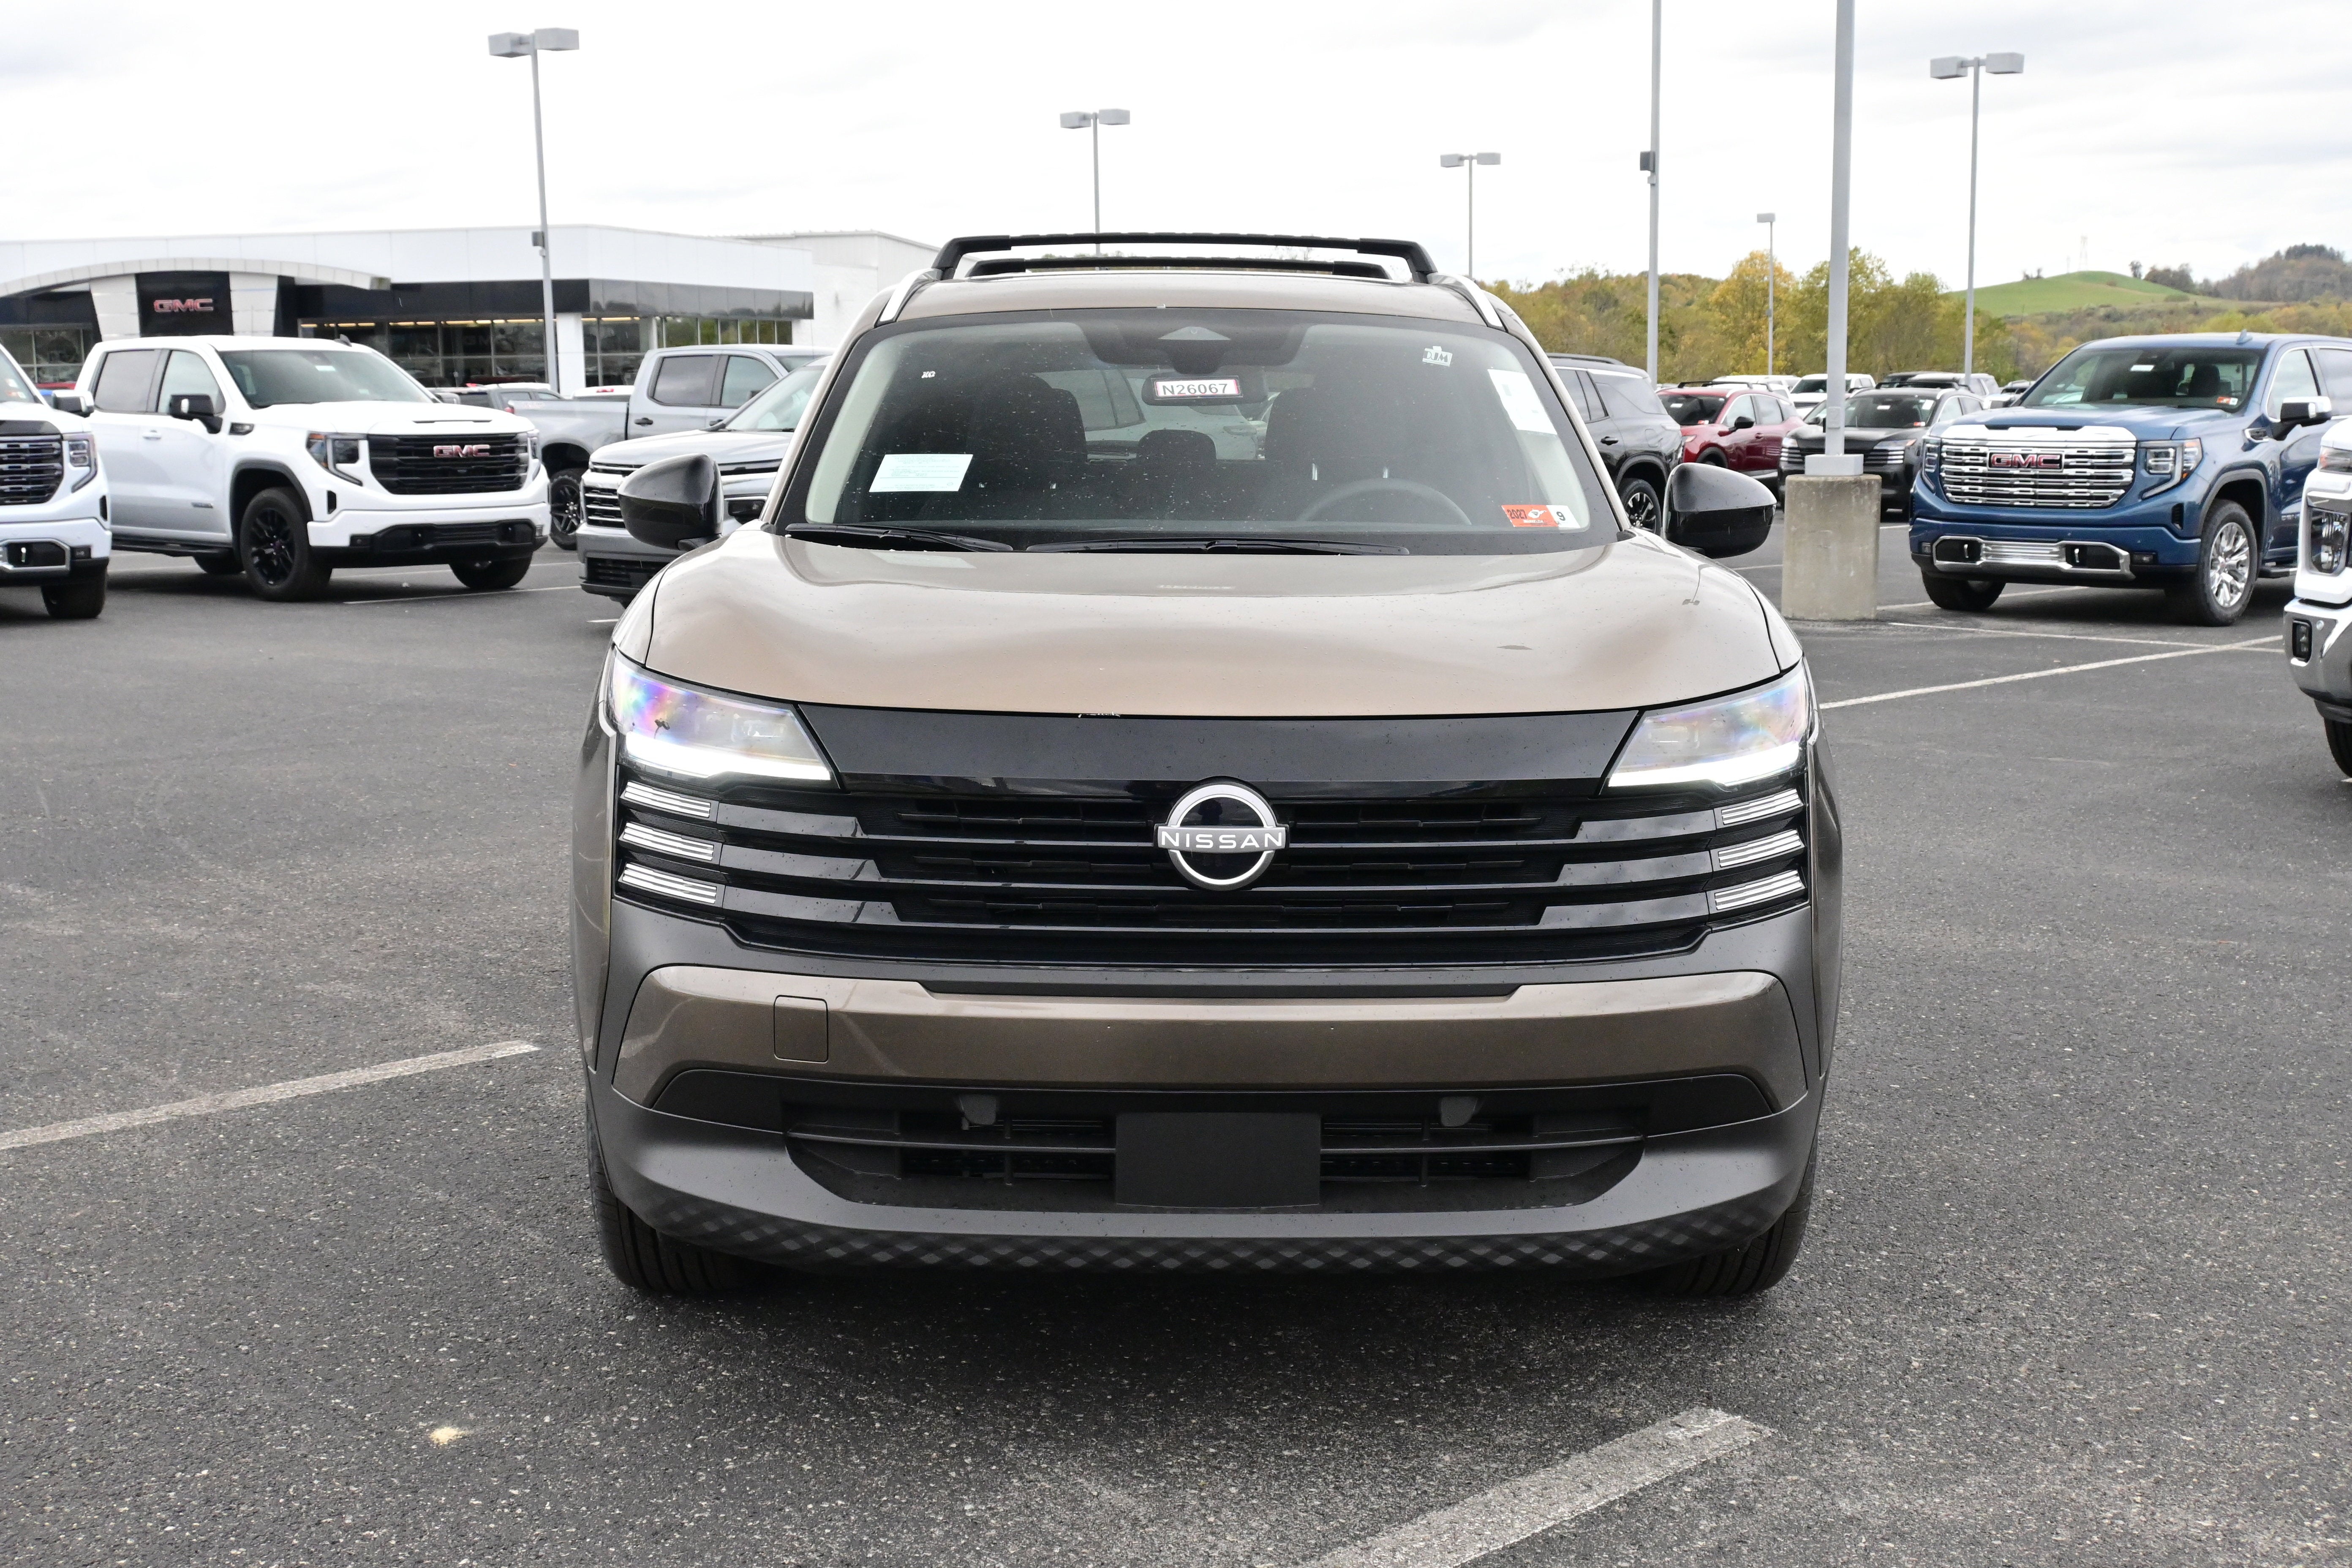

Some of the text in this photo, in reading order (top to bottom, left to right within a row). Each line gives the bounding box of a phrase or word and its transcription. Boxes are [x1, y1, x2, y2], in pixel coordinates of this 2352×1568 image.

[153, 298, 214, 313] GMC
[1162, 383, 1228, 395] N26067
[433, 444, 490, 457] GMC
[1991, 454, 2061, 468] GMC
[1507, 509, 1527, 519] 2027
[1556, 511, 1566, 521] 9
[1161, 830, 1282, 849] NISSAN
